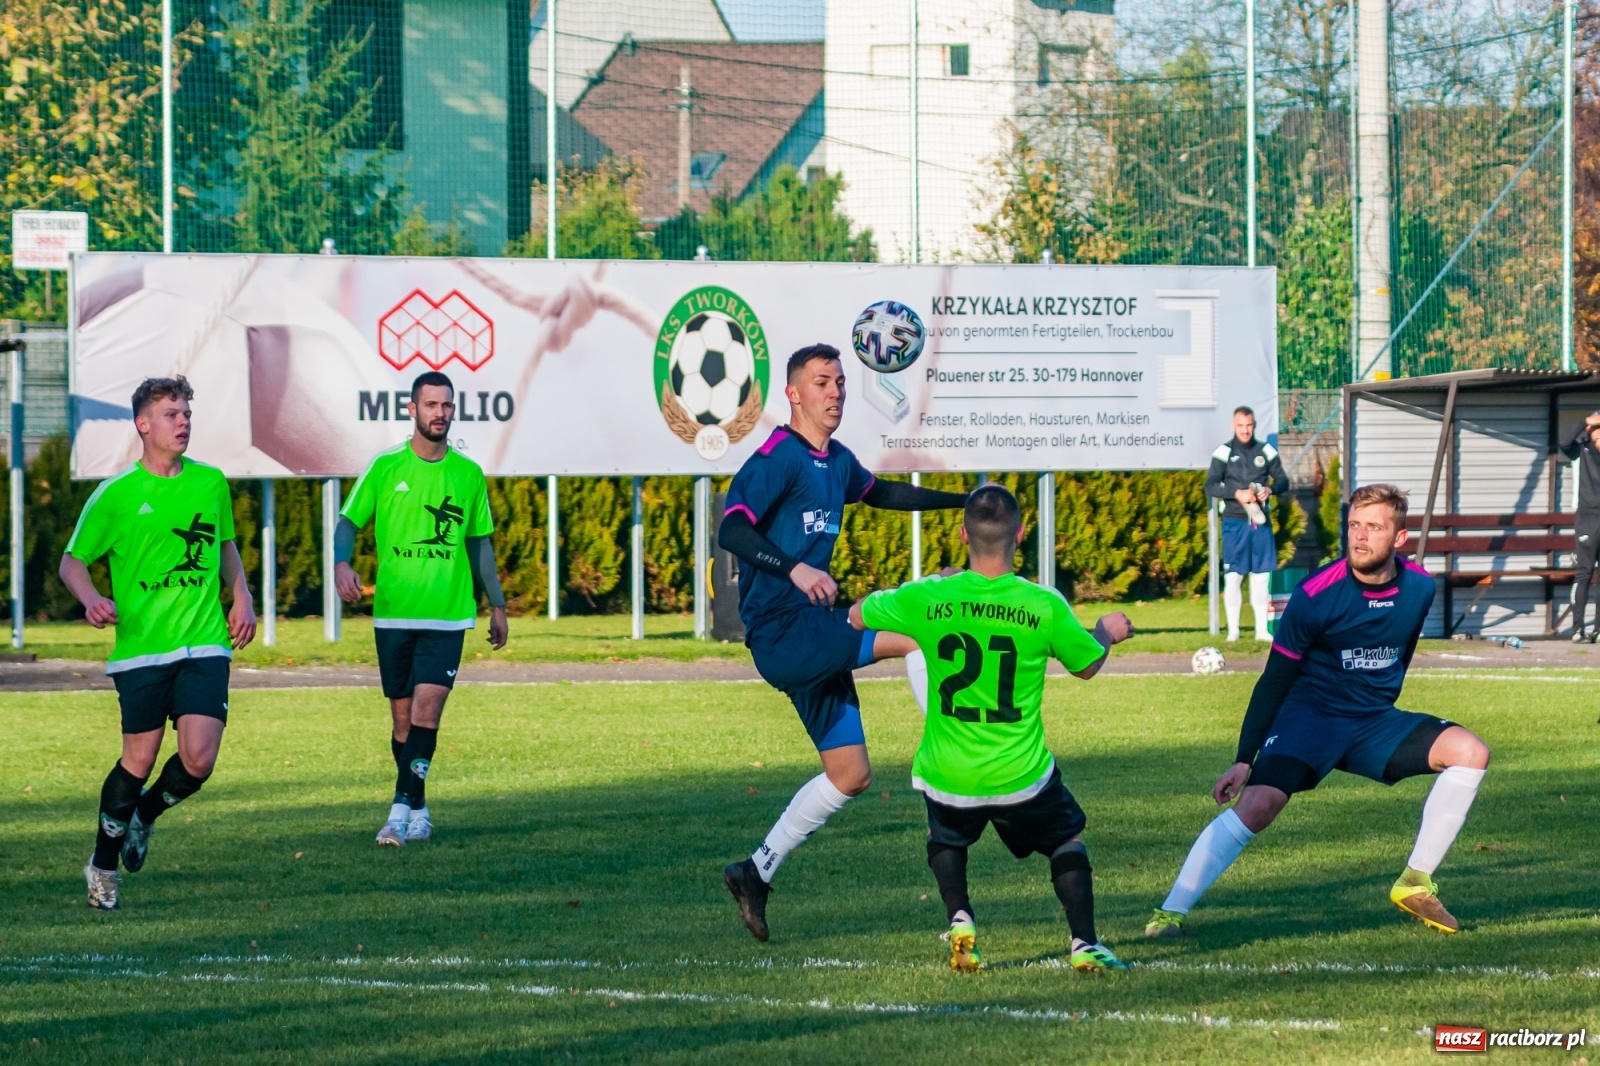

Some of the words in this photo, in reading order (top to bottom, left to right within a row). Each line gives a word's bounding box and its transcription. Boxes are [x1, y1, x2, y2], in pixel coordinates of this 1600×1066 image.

[931, 296, 1028, 316] KRZYKAŁA
[1032, 297, 1138, 316] KRZYSZTOF
[657, 314, 681, 360] LKS
[684, 290, 768, 361] TWORKÓW
[939, 327, 960, 338] von
[963, 325, 1029, 341] genormten
[1032, 324, 1104, 342] Fertigteilen,
[1106, 324, 1174, 338] Trockenbau
[925, 368, 985, 383] Plauener
[988, 369, 1006, 383] str
[1008, 368, 1029, 383] 25.
[1032, 368, 1078, 383] 30-179
[1080, 368, 1144, 382] Hannover
[358, 390, 515, 422] MELIO
[919, 412, 967, 428] Fenster,
[970, 412, 1026, 428] Rolladen,
[1096, 411, 1150, 427] Markisen
[985, 434, 1048, 451] Montagen
[1051, 433, 1076, 447] aller
[1080, 433, 1101, 449] Art,
[1104, 432, 1185, 447] Kundendienst
[756, 551, 782, 567] KIPSTA
[926, 602, 954, 621] LKS
[960, 601, 1041, 631] TWORKÓW
[937, 631, 1023, 724] 21
